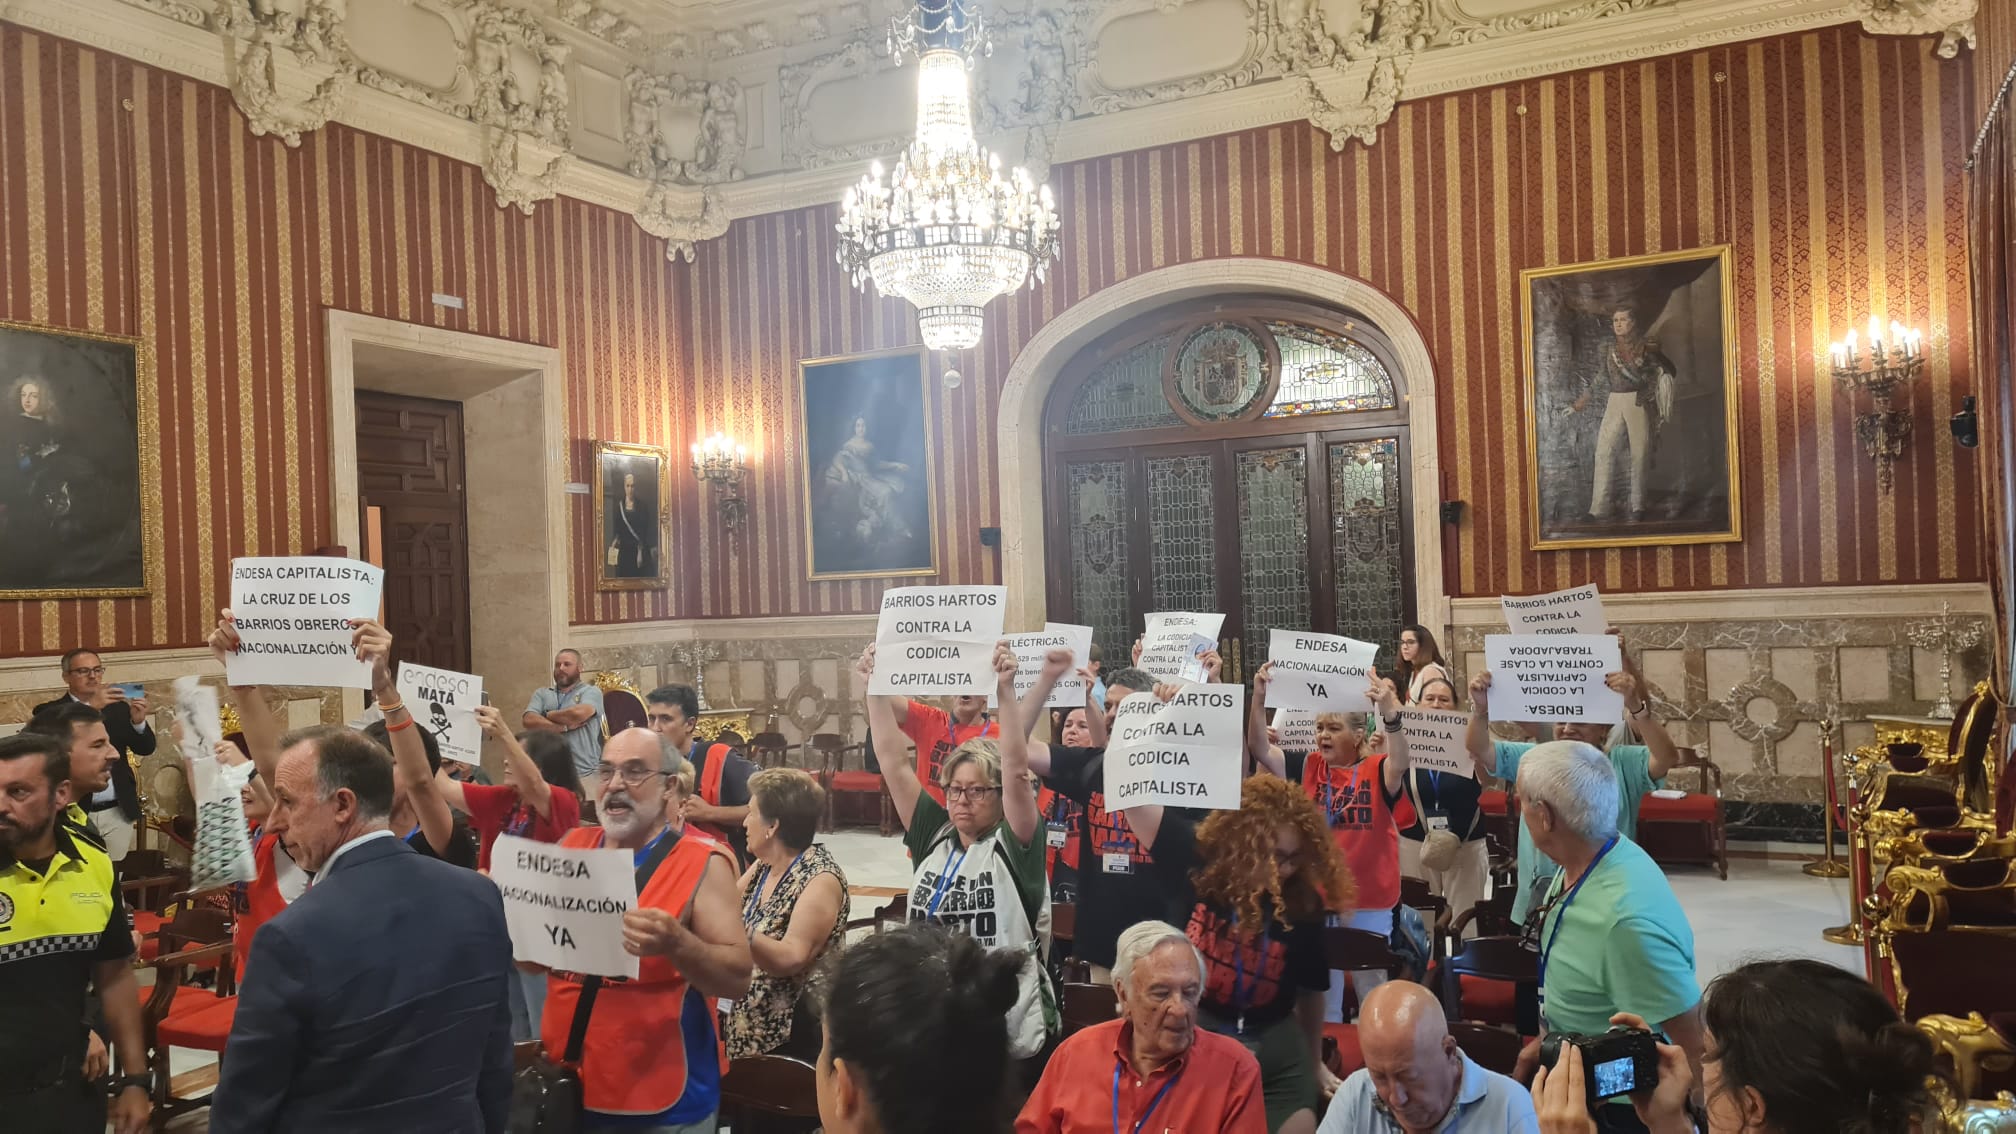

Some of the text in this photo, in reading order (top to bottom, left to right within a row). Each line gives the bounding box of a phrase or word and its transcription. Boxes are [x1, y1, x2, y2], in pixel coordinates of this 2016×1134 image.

[235, 566, 375, 586] ENDESA CAPITALISTA:
[243, 592, 351, 606] LA CRUZ DE LOS
[884, 593, 998, 609] BARRIOS HARTOS
[1504, 590, 1593, 609] BARRIOS HARTOS
[236, 618, 291, 630] BARRIOS
[1522, 610, 1582, 624] CONTRA LA
[896, 620, 972, 634] CONTRA LA
[1535, 626, 1579, 635] CODICIA
[1151, 644, 1188, 652] CAPITALIST
[1295, 638, 1348, 654] ENDESA
[1509, 646, 1593, 655] TRABAJADORA
[906, 647, 961, 660] CODICIA
[1167, 655, 1177, 663] LA
[1148, 667, 1180, 675] TRABAJAD
[1272, 659, 1365, 677] NACIONALIZACIÓN
[1500, 660, 1604, 669] CONTRA LA CLASE
[890, 672, 973, 686] CAPITALISTA
[1516, 673, 1587, 682] CAPITALISTA
[418, 686, 455, 705] MATA
[1306, 682, 1329, 699] YA
[1521, 686, 1584, 695] LA CODICIA
[1525, 704, 1584, 716] ENDESA:
[1426, 713, 1469, 726] HARTOS
[1183, 722, 1205, 736] LA
[1284, 729, 1316, 737] CAPITAL
[1402, 728, 1453, 741] NTRA LA
[1408, 743, 1446, 753] ODICIA
[1128, 751, 1190, 766] CODICIA
[1411, 756, 1459, 769] ITALISTA
[1118, 780, 1208, 798] CAPITALISTA
[516, 851, 591, 880] ENDESA
[501, 885, 627, 914] ACIONALIZACIÓN
[544, 923, 577, 950] YA
